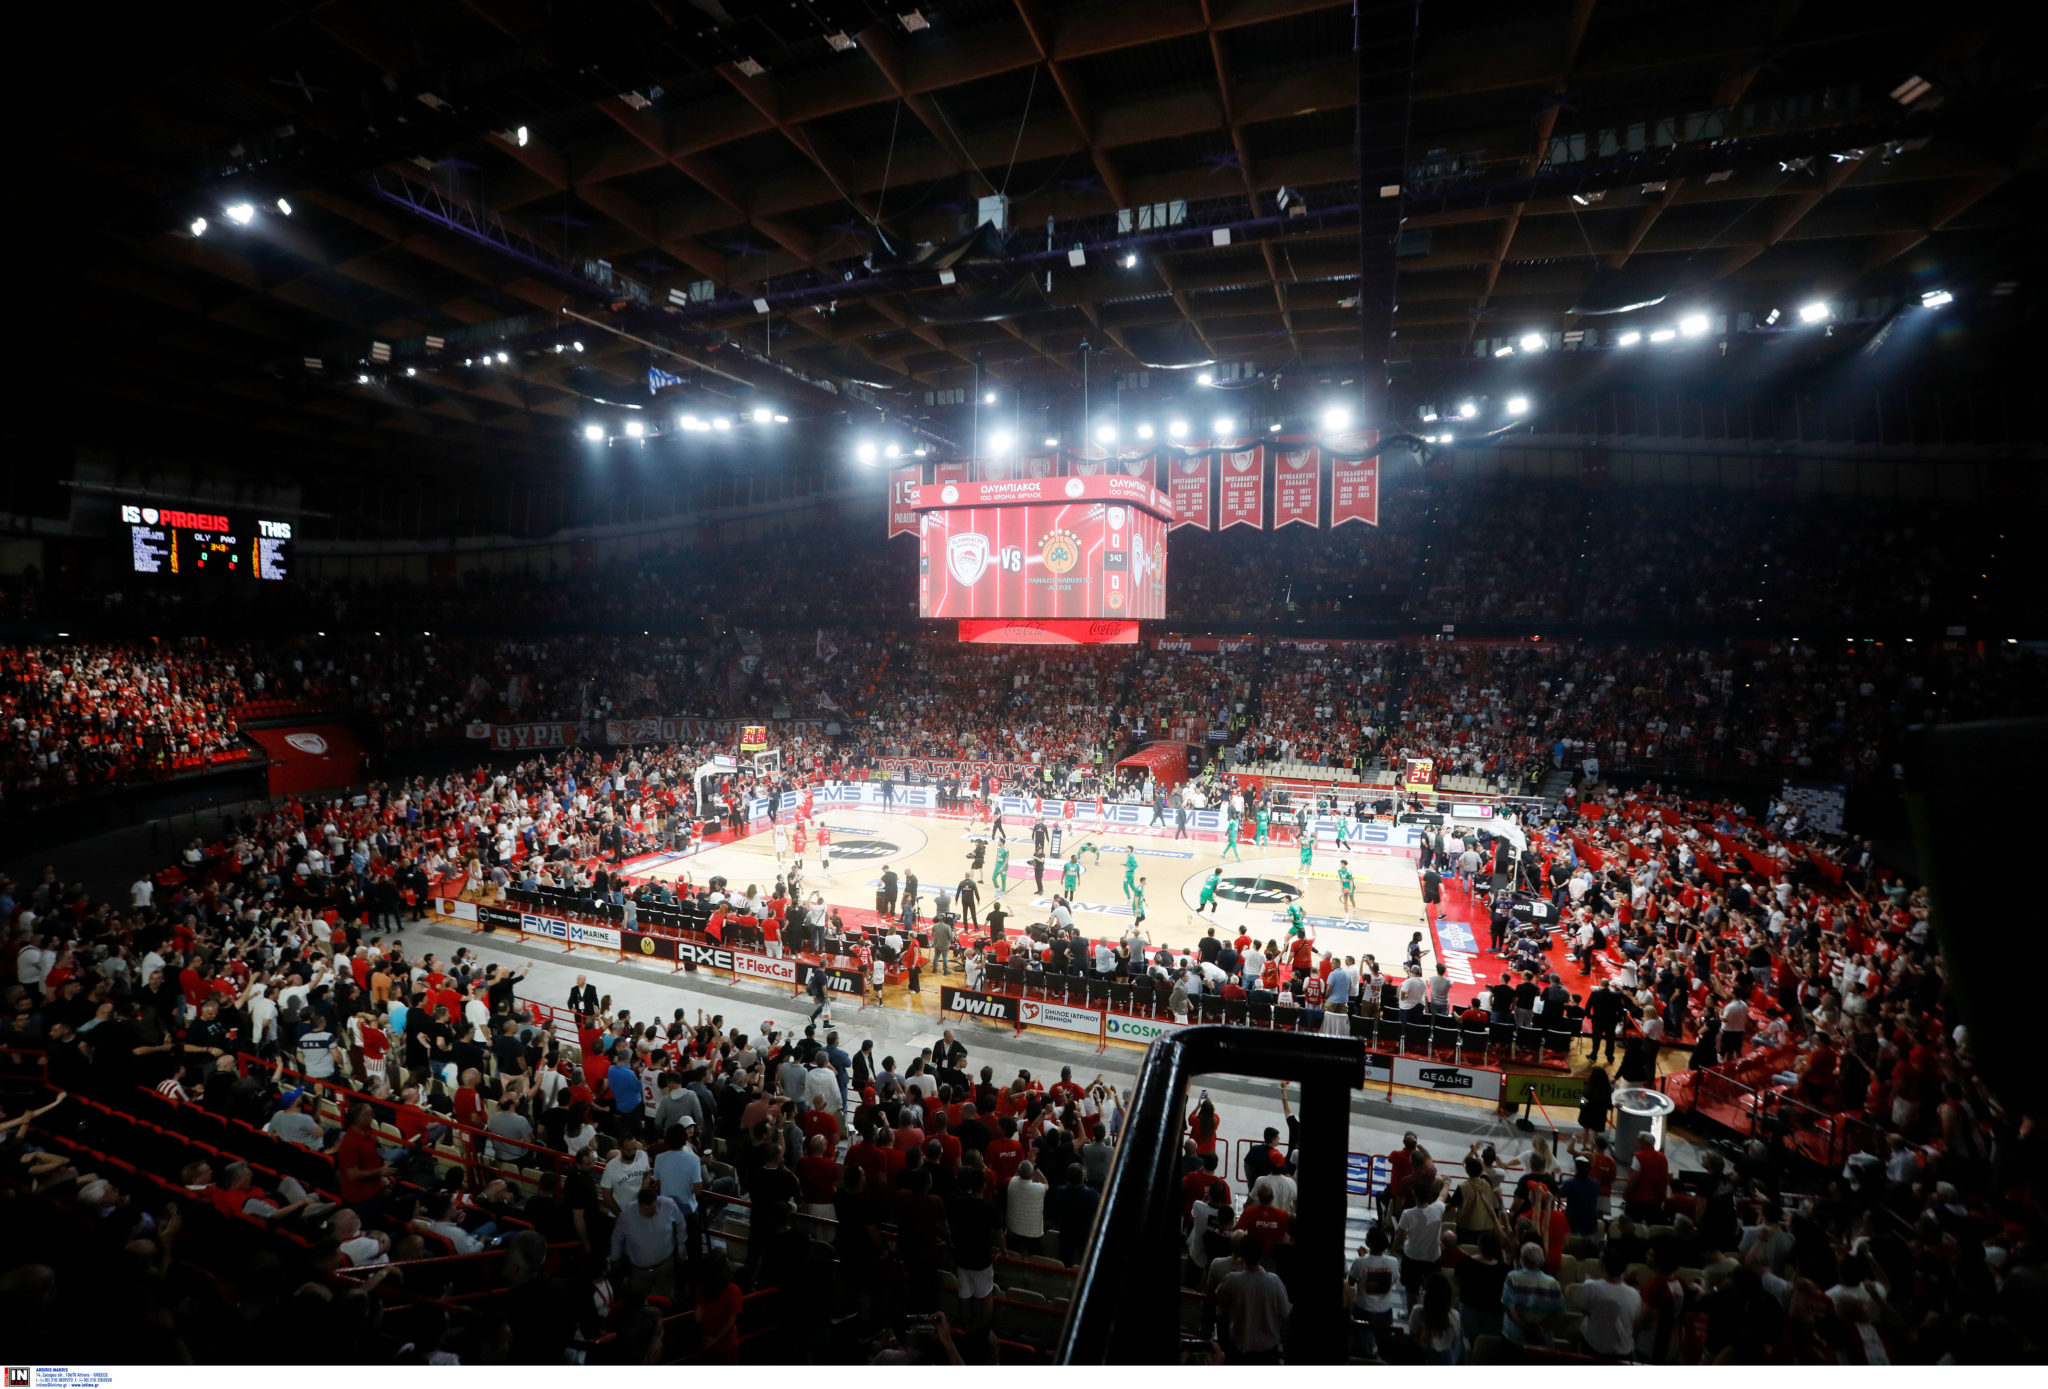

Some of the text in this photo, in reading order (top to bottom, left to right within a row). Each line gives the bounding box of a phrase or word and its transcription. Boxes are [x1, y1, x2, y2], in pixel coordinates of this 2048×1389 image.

[981, 482, 1041, 494] ΟΛΥΜΠΙΑΚΟΣ
[121, 505, 230, 532] IS PIRAEUS
[258, 520, 292, 539] THIS
[1112, 533, 1120, 548] 0
[1001, 548, 1021, 572] VS
[1111, 574, 1120, 590] 0
[1157, 638, 1191, 650] bwin
[496, 725, 565, 748] ΘΥΡΑ
[1410, 771, 1430, 783] 24
[1002, 798, 1062, 816] FMS
[1076, 802, 1139, 822] FMS
[1314, 820, 1388, 842] FMS
[489, 913, 507, 922] NEVER
[523, 915, 566, 936] FMS
[583, 929, 609, 941] MARINE
[678, 943, 732, 969] AXE
[746, 959, 793, 978] FlexCar
[1441, 950, 1487, 985] bwin
[951, 991, 1006, 1018] bwin
[1044, 1008, 1099, 1022] ΟΜΙΛΟΣ ΙΑΤΡΙΚΟΥ
[1045, 1014, 1072, 1024] ΑΘΗΝΩΝ
[1422, 1071, 1471, 1086] ΔΕΔΔΗΕ
[644, 1087, 653, 1100] 3
[1540, 1083, 1584, 1099] Pirae
[1256, 1220, 1279, 1229] FMS
